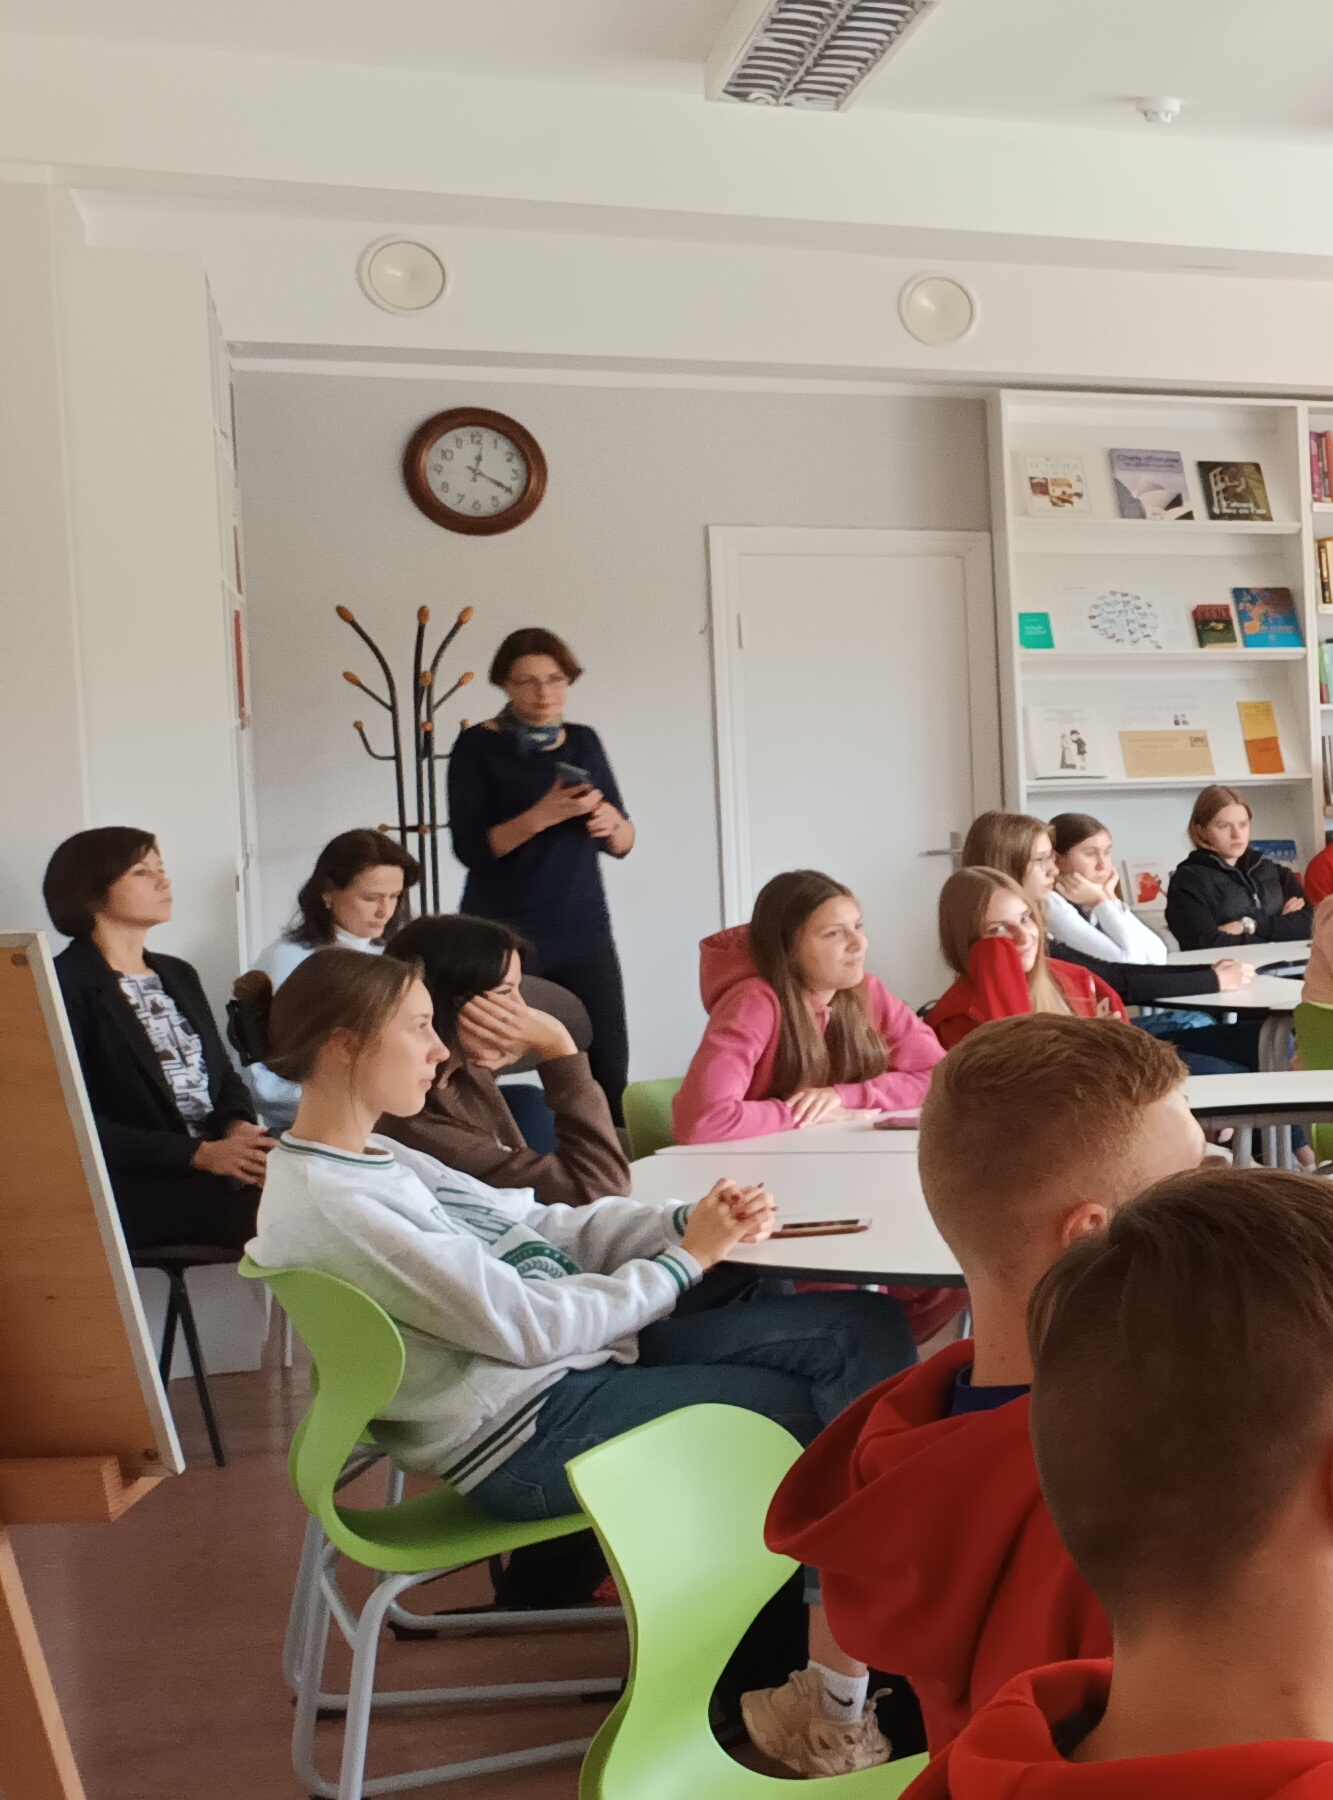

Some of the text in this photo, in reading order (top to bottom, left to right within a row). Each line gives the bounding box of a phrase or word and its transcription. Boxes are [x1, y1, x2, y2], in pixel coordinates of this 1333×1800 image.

[470, 431, 483, 445] 12
[440, 449, 454, 461] 10
[505, 450, 515, 463] 2
[434, 463, 443, 475] 9
[457, 493, 465, 504] 7
[472, 499, 482, 511] 6
